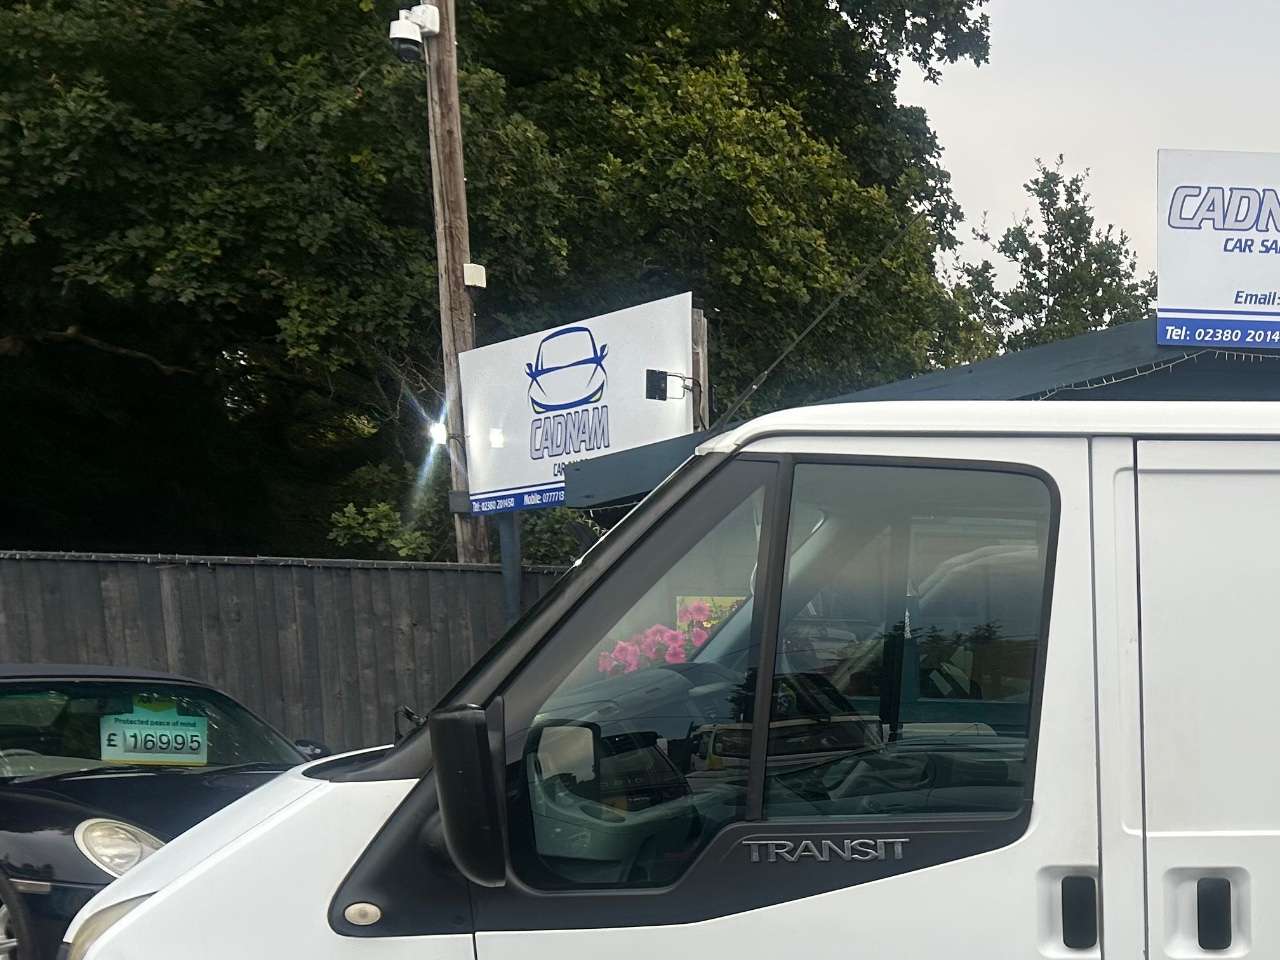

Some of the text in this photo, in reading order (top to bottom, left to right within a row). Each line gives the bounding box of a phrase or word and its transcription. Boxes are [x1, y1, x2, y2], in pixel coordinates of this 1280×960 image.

[1223, 237, 1255, 254] CAR
[1234, 290, 1280, 306] Email:
[1165, 325, 1191, 341] Tel:
[1195, 328, 1242, 342] 02380
[529, 404, 610, 460] CADNAM
[742, 839, 910, 862] TRANSIT
